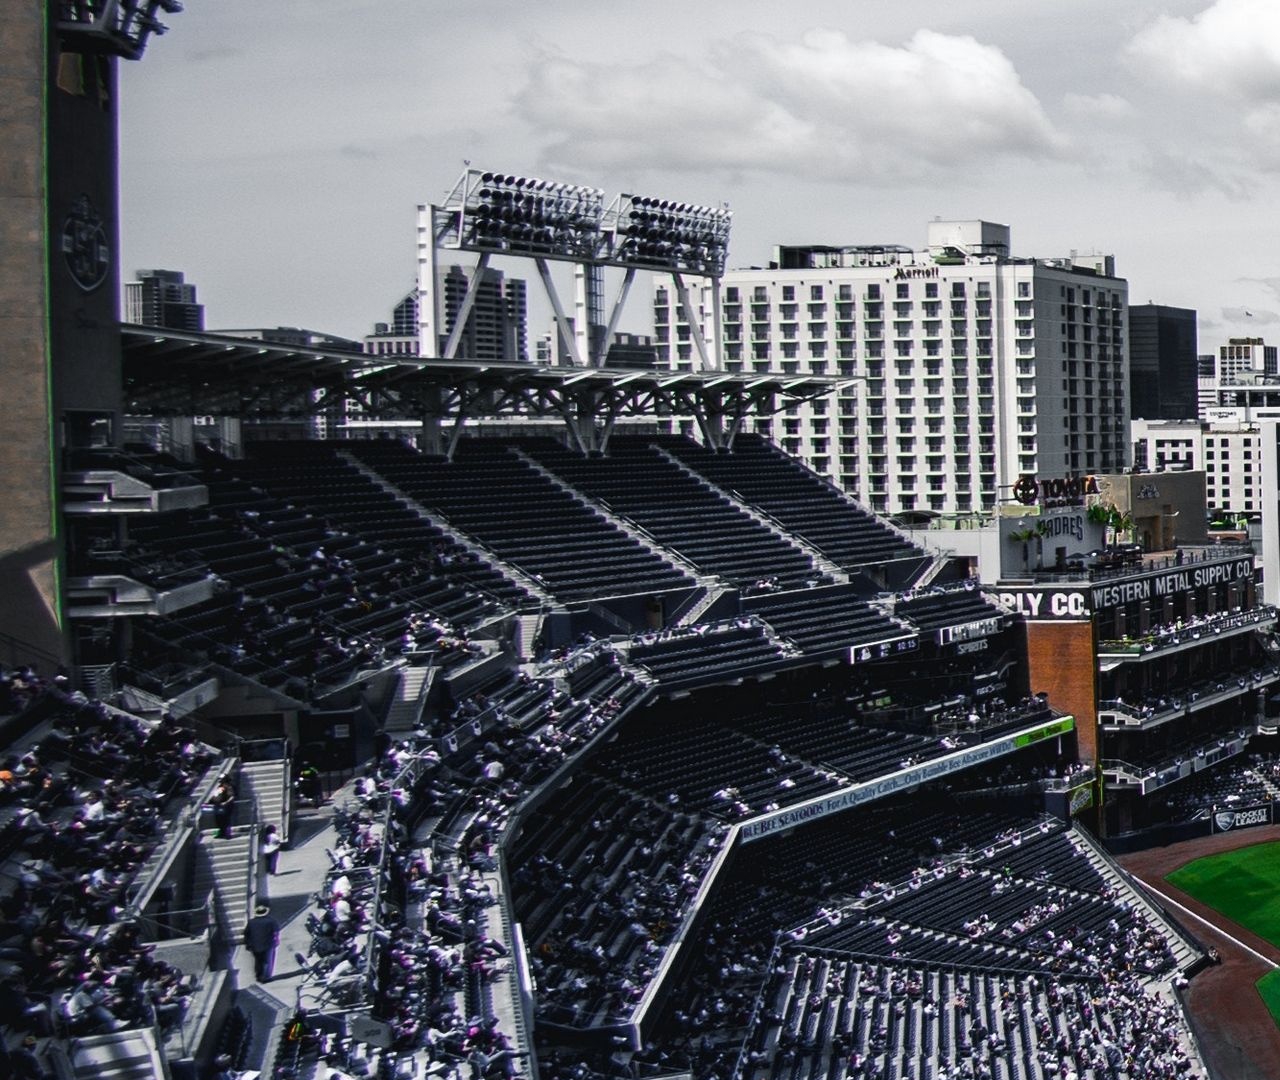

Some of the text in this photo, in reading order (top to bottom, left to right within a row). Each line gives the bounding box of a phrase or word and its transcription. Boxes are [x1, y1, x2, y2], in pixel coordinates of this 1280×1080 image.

[1093, 560, 1255, 609] WESTERN METAL SUPPLY CO.
[1051, 592, 1091, 616] CO.
[957, 640, 989, 655] SPIRITS
[761, 817, 778, 834] BEE
[779, 804, 824, 828] SEAFOODS
[827, 800, 841, 811] For
[842, 796, 849, 806] A
[850, 787, 877, 805] Quality
[922, 762, 949, 780] Bumble
[949, 757, 961, 770] Bee
[962, 747, 989, 767] Albacore
[1235, 808, 1267, 821] ROCKET
[1235, 814, 1268, 826] LEAGUE
